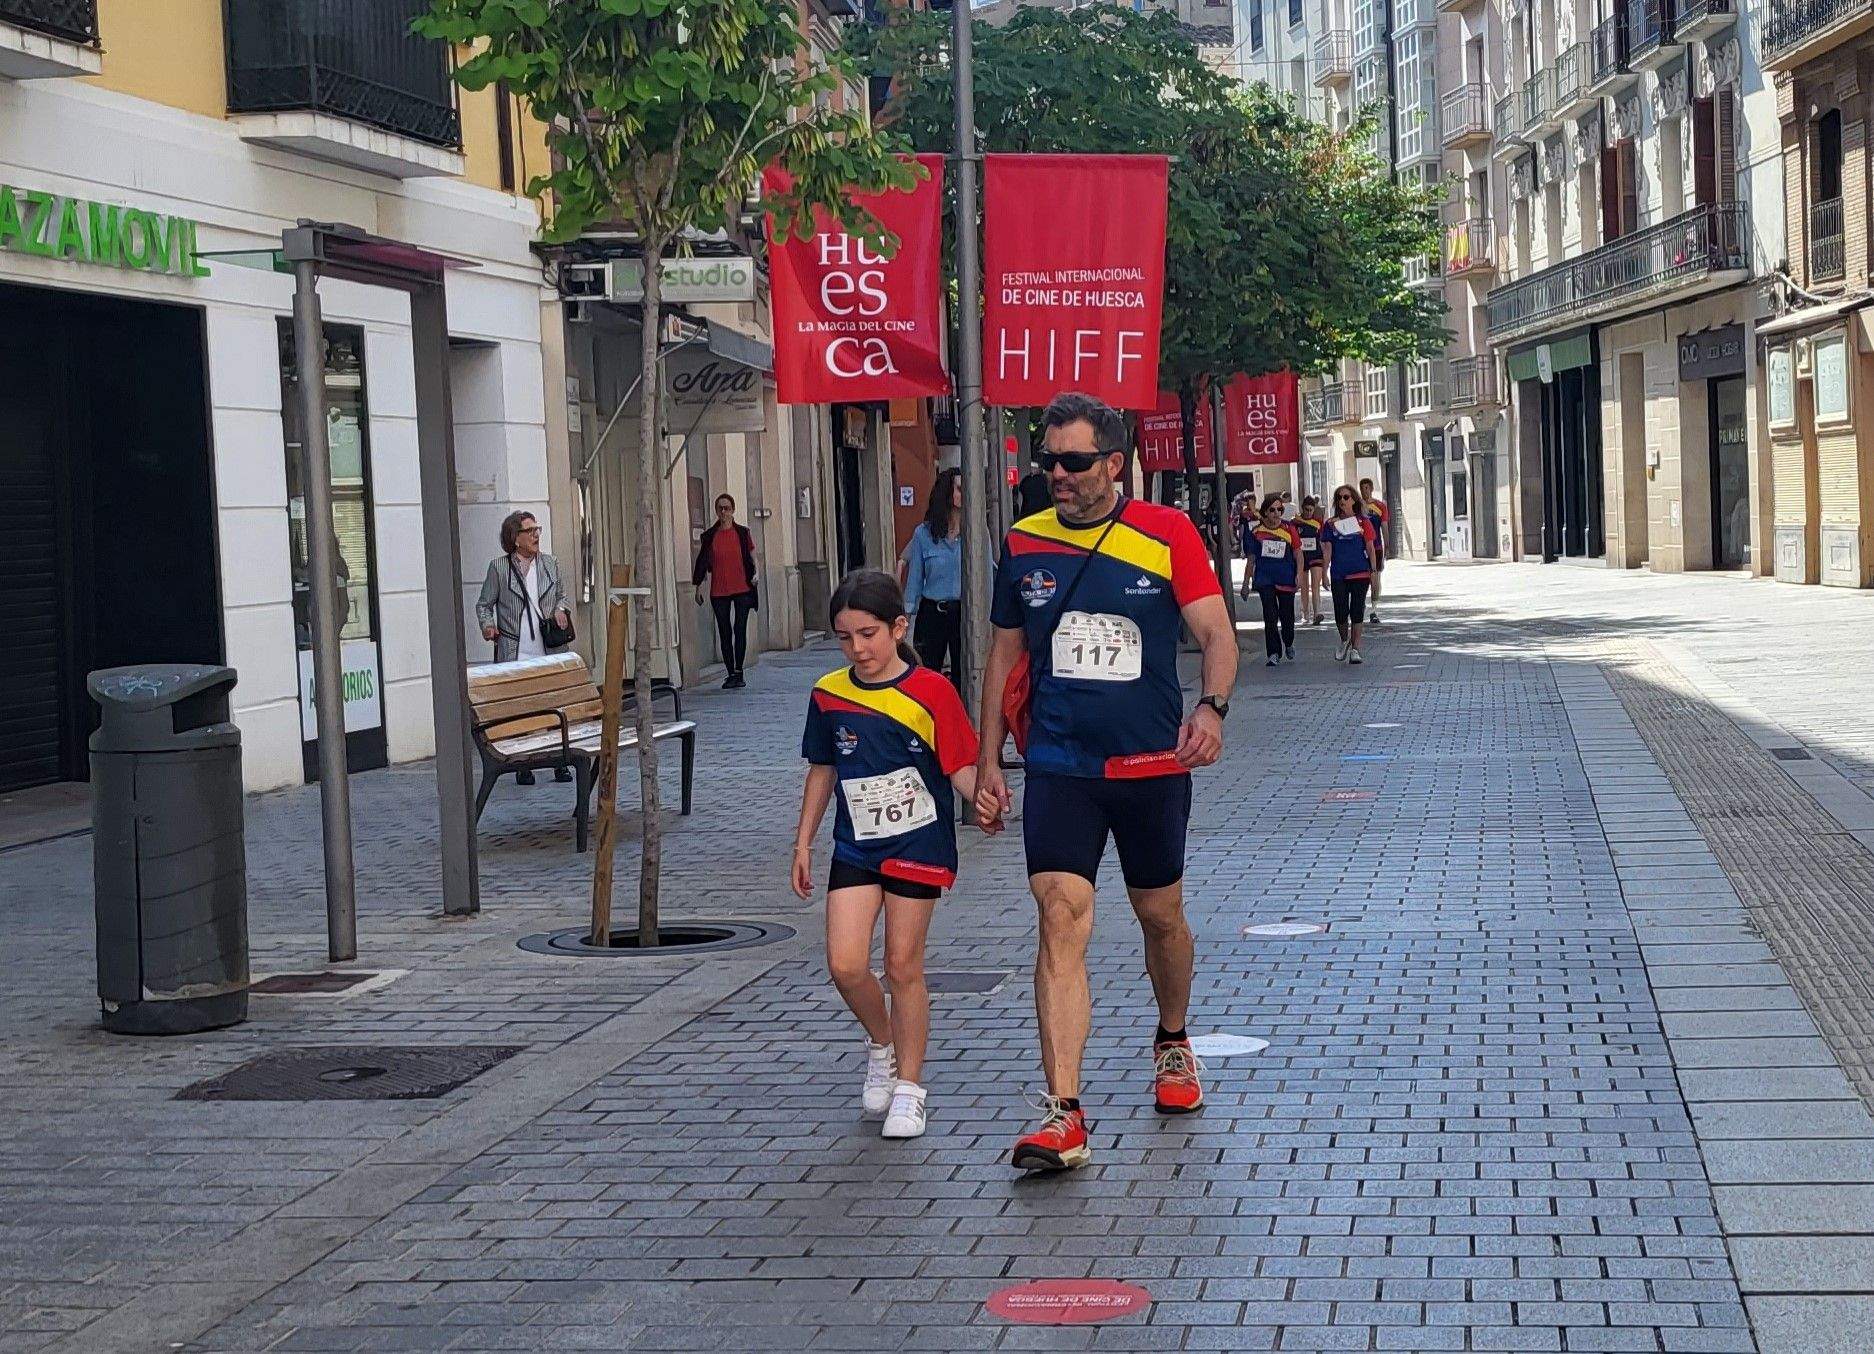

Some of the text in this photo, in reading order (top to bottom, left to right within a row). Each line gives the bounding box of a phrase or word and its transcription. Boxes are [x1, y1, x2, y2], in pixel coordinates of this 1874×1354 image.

[0, 184, 211, 277] AZAMOVIL
[1002, 267, 1145, 286] FESTIVAL INTERNACIONAL
[820, 269, 888, 316] es
[1002, 288, 1145, 308] DE CINE DE HUESCA
[825, 336, 900, 378] ca
[1000, 328, 1144, 383] HIFF
[1247, 409, 1277, 429] es
[1145, 435, 1205, 462] HIFF
[1248, 436, 1280, 455] ca
[1072, 644, 1122, 667] 117
[867, 797, 916, 826] 767
